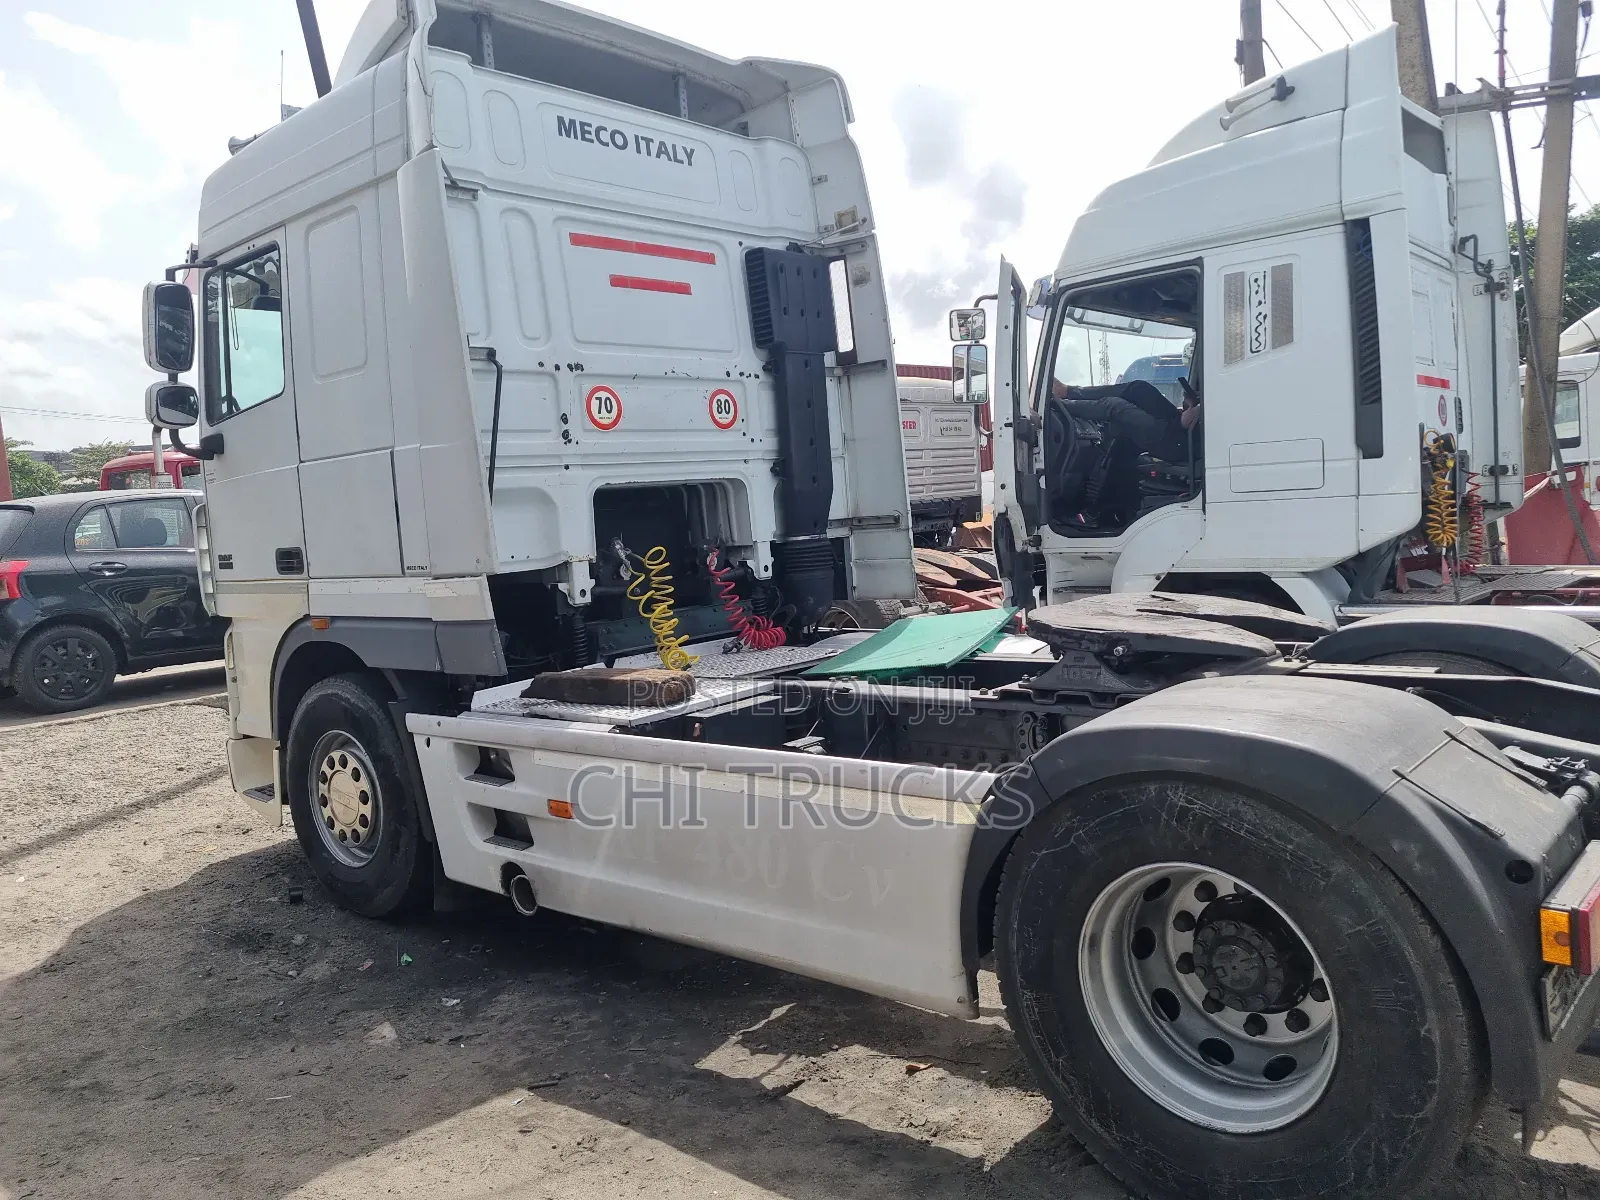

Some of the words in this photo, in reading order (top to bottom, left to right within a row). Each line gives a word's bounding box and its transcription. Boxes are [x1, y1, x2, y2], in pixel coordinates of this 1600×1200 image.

[557, 115, 628, 150] MECO
[634, 134, 695, 166] ITALY
[595, 396, 613, 414] 70
[716, 398, 731, 415] 80
